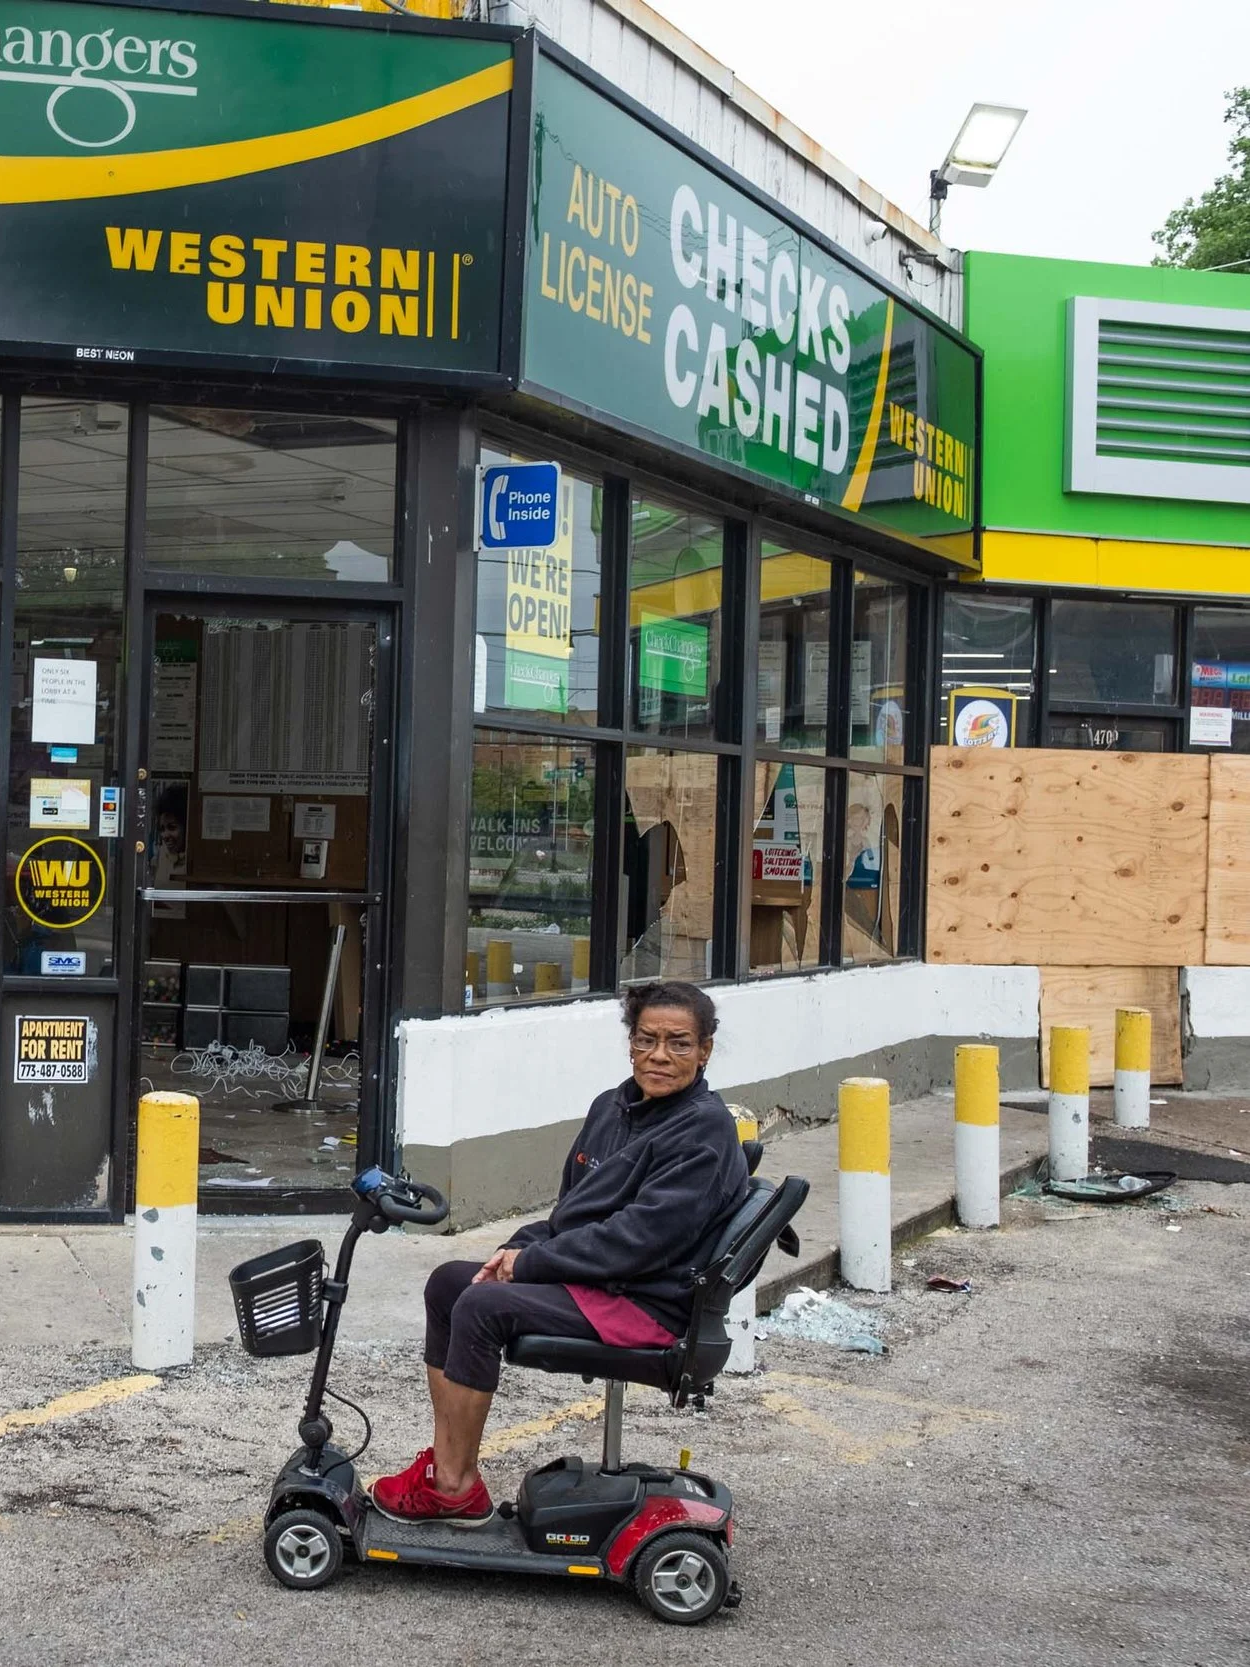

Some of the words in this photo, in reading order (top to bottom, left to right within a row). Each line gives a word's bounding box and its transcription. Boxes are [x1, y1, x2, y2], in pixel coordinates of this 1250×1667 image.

[568, 165, 638, 257] AUTO
[105, 227, 420, 291] WESTERN
[540, 232, 654, 345] LICENSE
[670, 184, 851, 375] CHECKS
[207, 281, 419, 338] UNION
[76, 347, 104, 359] BEST
[105, 349, 135, 361] NEON
[664, 303, 850, 475] CASHED
[890, 400, 965, 478] WESTERN
[509, 491, 551, 505] Phone
[914, 459, 964, 519] UNION
[508, 508, 550, 521] Inside
[511, 550, 568, 596] WE'RE
[508, 592, 568, 642] OPEN!
[764, 848, 797, 856] LOITERING
[37, 860, 90, 887] WU
[764, 867, 800, 876] SMOKING
[35, 890, 89, 898] WESTERN
[52, 899, 89, 907] UNION
[48, 957, 81, 965] SMG
[22, 1021, 84, 1038] APARTMENT
[21, 1039, 46, 1059] FOR
[50, 1039, 84, 1060] RENT
[21, 1064, 83, 1078] 773-487-0588
